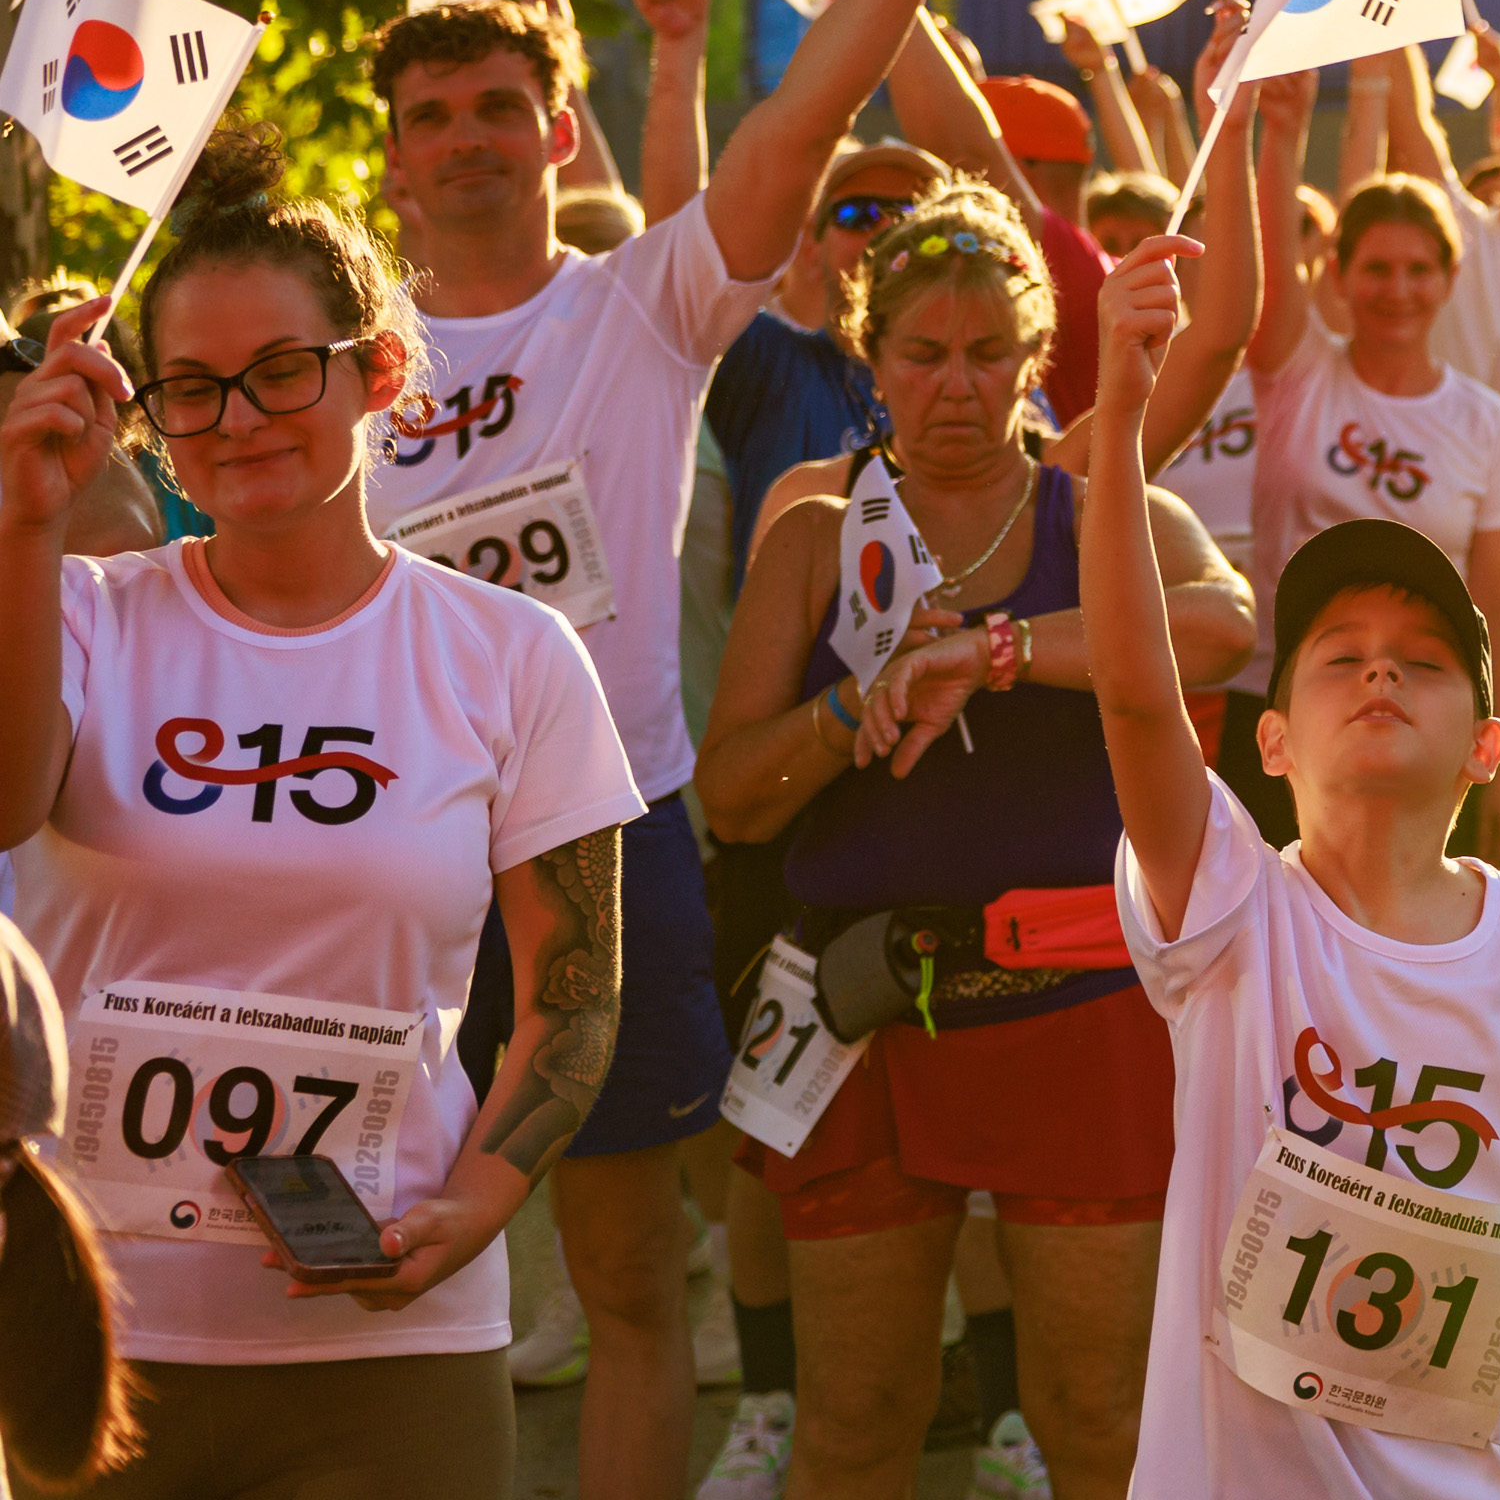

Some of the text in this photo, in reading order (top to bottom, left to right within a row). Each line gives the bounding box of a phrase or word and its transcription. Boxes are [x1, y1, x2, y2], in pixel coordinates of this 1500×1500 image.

[1327, 421, 1433, 501] 815
[428, 518, 570, 592] 29
[143, 717, 400, 826] 815
[103, 993, 409, 1047] Fuss Koreáért a felszabadulás napján!
[741, 999, 821, 1087] 21
[73, 1036, 120, 1164] 19450815
[121, 1056, 361, 1168] 097
[354, 1069, 401, 1196] 20250815
[1282, 1026, 1500, 1189] 815
[1276, 1146, 1306, 1174] Fuss
[1306, 1160, 1373, 1202] Koreáért
[1373, 1190, 1386, 1208] a
[1387, 1193, 1489, 1236] felszabadulás
[1225, 1188, 1283, 1312] 19450815
[1282, 1229, 1479, 1369] 131
